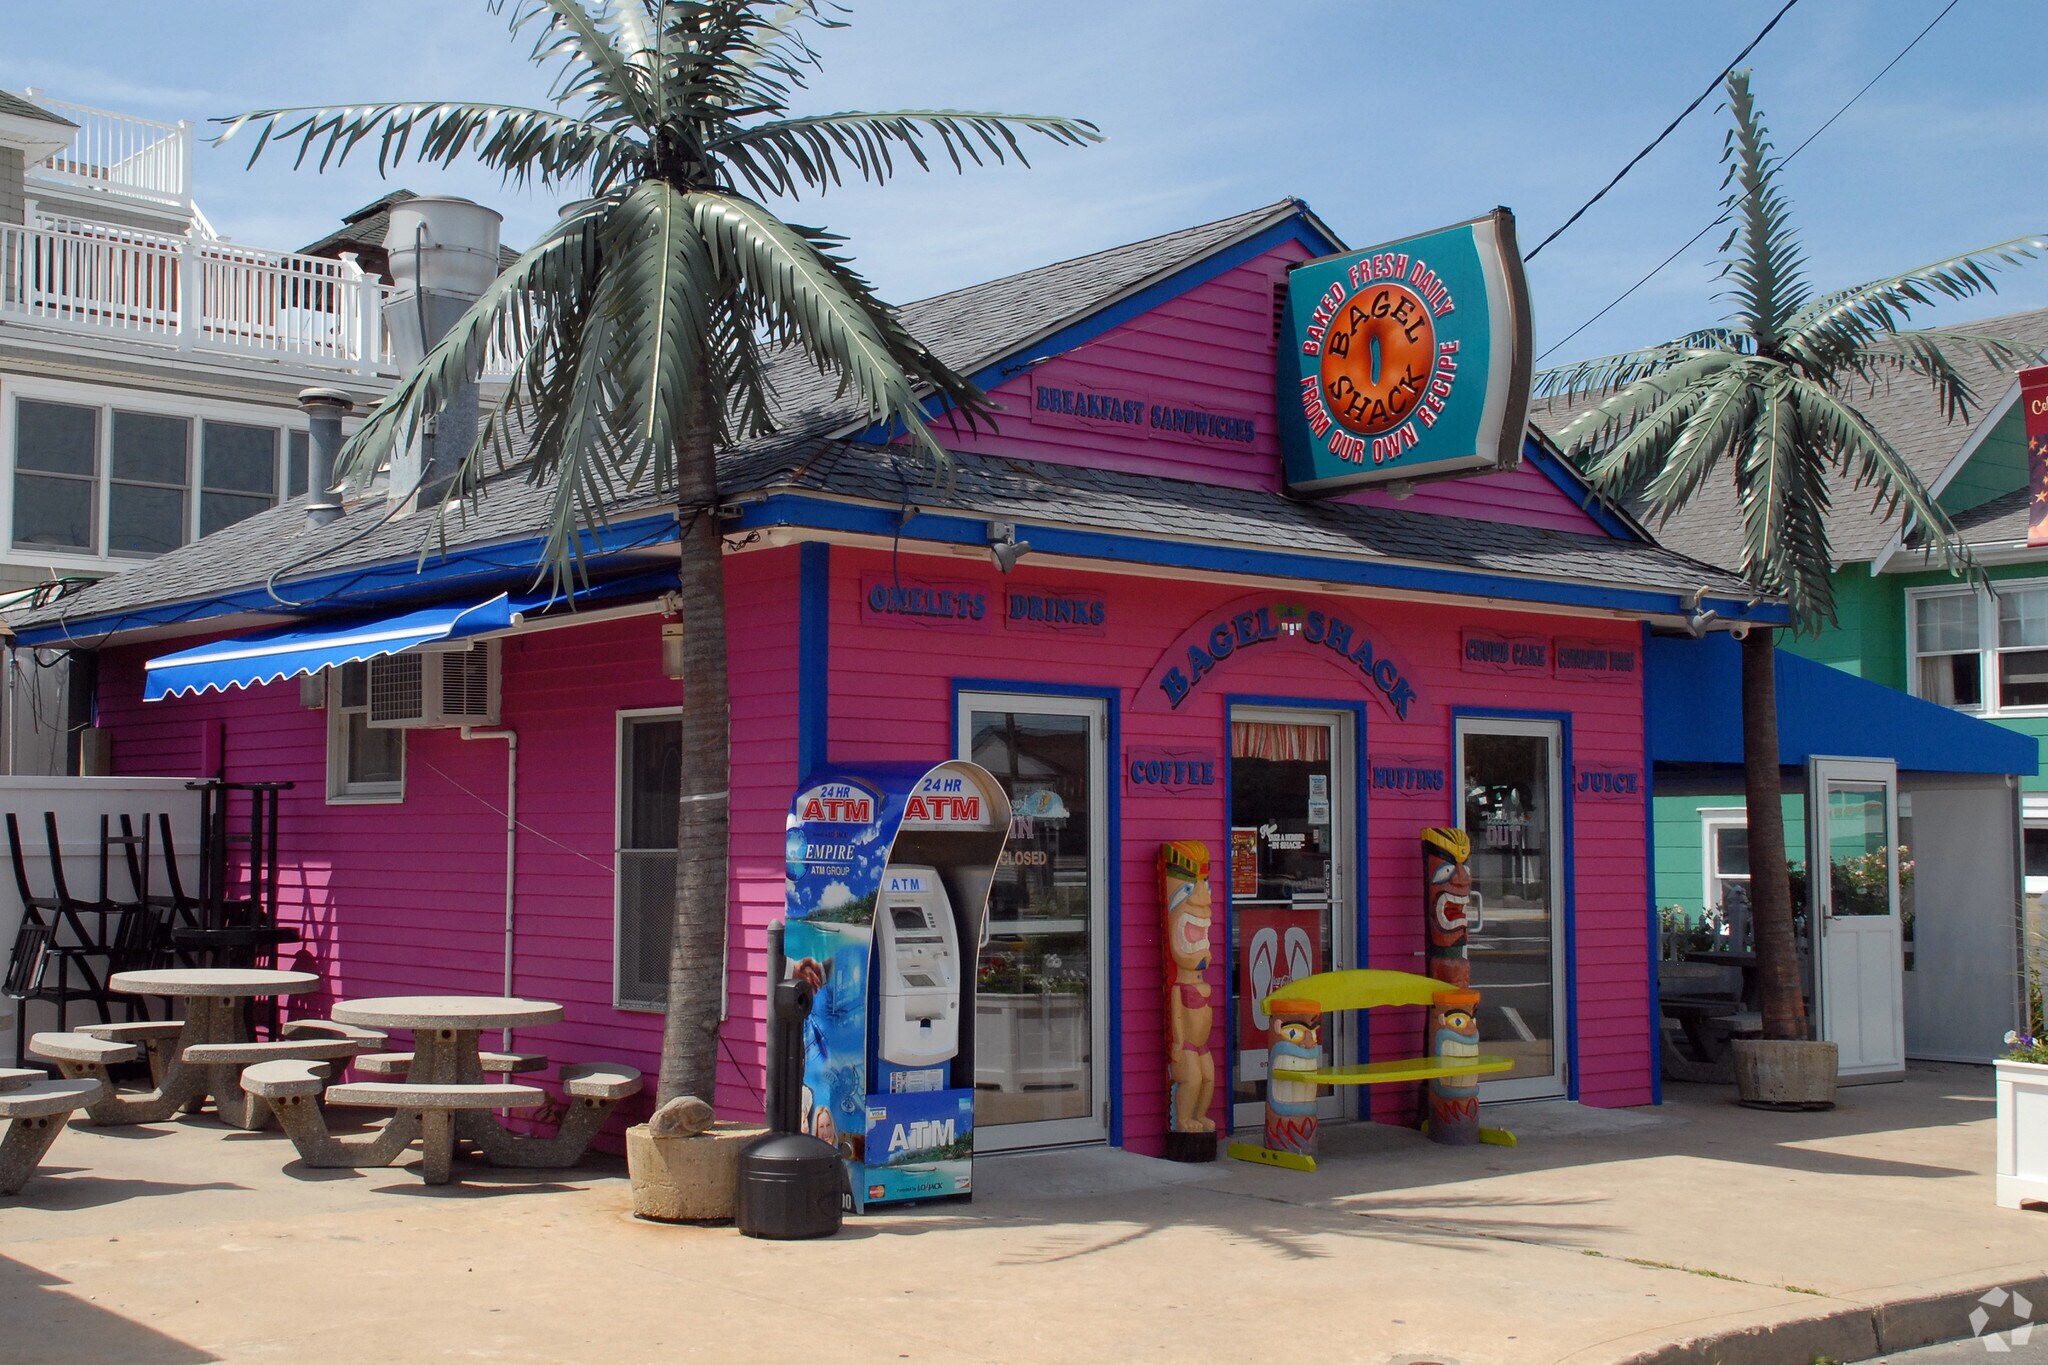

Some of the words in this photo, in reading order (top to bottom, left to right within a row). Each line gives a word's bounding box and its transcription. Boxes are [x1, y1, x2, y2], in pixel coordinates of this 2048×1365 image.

[1301, 281, 1347, 356] BAKED
[1348, 252, 1409, 289] FRESH
[1409, 260, 1457, 318] DAILY
[1328, 290, 1426, 359] BAGEL
[1300, 375, 1332, 439] FROM
[1328, 429, 1366, 464] OUR
[1372, 422, 1420, 464] OWN
[1417, 340, 1460, 428] RECIPE
[1328, 363, 1425, 426] SHACK
[1036, 386, 1145, 425] BREAKFAST
[1151, 404, 1255, 443] SANDWICHES
[869, 583, 986, 621] OMELETS
[1009, 594, 1105, 625] DRINKS
[1160, 607, 1279, 710] BAGEL
[1304, 610, 1417, 721] SHACK
[1466, 639, 1509, 663] CRUMB
[1513, 643, 1546, 667] CAKE
[923, 778, 941, 792] 24
[944, 778, 962, 792] HR
[1131, 760, 1215, 785] COFFEE
[1372, 767, 1444, 791] MUFFINS
[1578, 772, 1638, 794] JUICE
[820, 786, 835, 798] 24
[836, 786, 850, 798] HR
[802, 798, 869, 822] ATM
[904, 796, 980, 821] ATM
[1486, 826, 1521, 846] OUT
[806, 844, 855, 860] EMPIRE
[1000, 850, 1047, 866] CLOSED
[811, 865, 825, 875] ATM
[826, 866, 850, 876] GROUP
[891, 878, 920, 890] ATM
[888, 1119, 954, 1152] ATM
